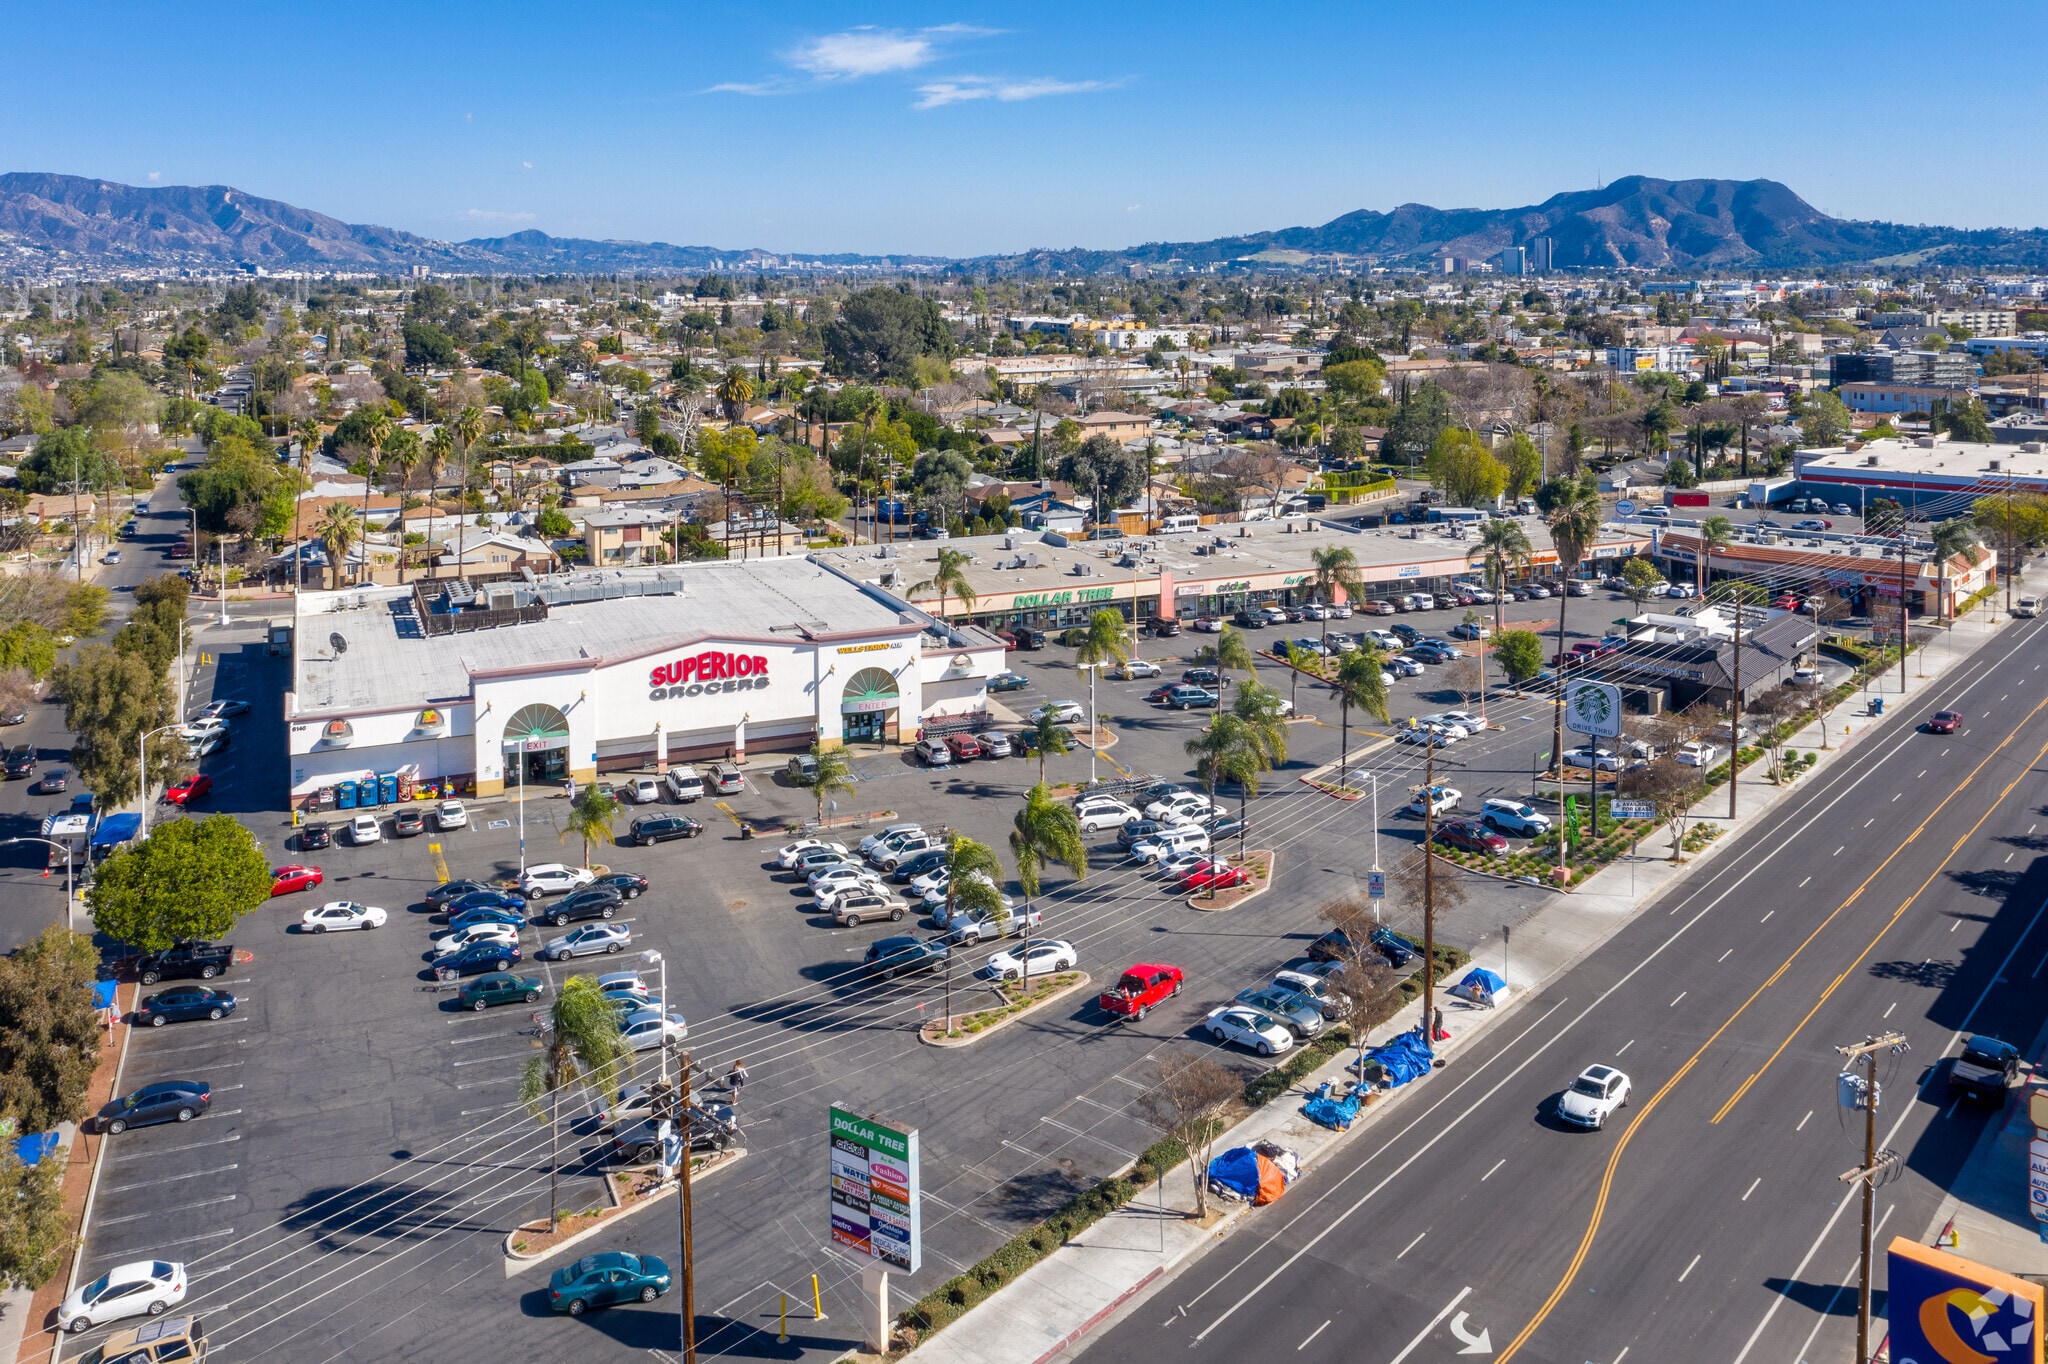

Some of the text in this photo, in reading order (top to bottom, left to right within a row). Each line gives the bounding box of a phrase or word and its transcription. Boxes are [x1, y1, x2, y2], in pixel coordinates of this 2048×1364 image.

[1682, 553, 1697, 561] CLINIC
[1216, 580, 1251, 594] cricket
[1013, 586, 1115, 609] DOLLAR TREE
[837, 646, 864, 655] WELLS
[864, 643, 890, 653] FARGO
[650, 651, 769, 687] SUPERIOR
[649, 676, 770, 701] GROCERS
[858, 701, 887, 711] ENTER
[1572, 722, 1613, 736] DRIVE THRU
[526, 741, 548, 750] EXIT
[833, 1117, 905, 1153] DOLLAR TREE
[835, 1139, 865, 1158] cricket
[842, 1165, 871, 1183] WATER
[875, 1164, 903, 1182] Fashion
[841, 1185, 853, 1194] FAST
[854, 1190, 869, 1200] FOOD
[843, 1180, 865, 1193] CHINESE
[832, 1219, 852, 1232] metro
[871, 1210, 888, 1221] MARKET
[892, 1217, 909, 1228] BAKERY
[878, 1220, 904, 1236] OneMain
[873, 1236, 892, 1250] MEDICAL
[893, 1244, 909, 1257] CLINIC
